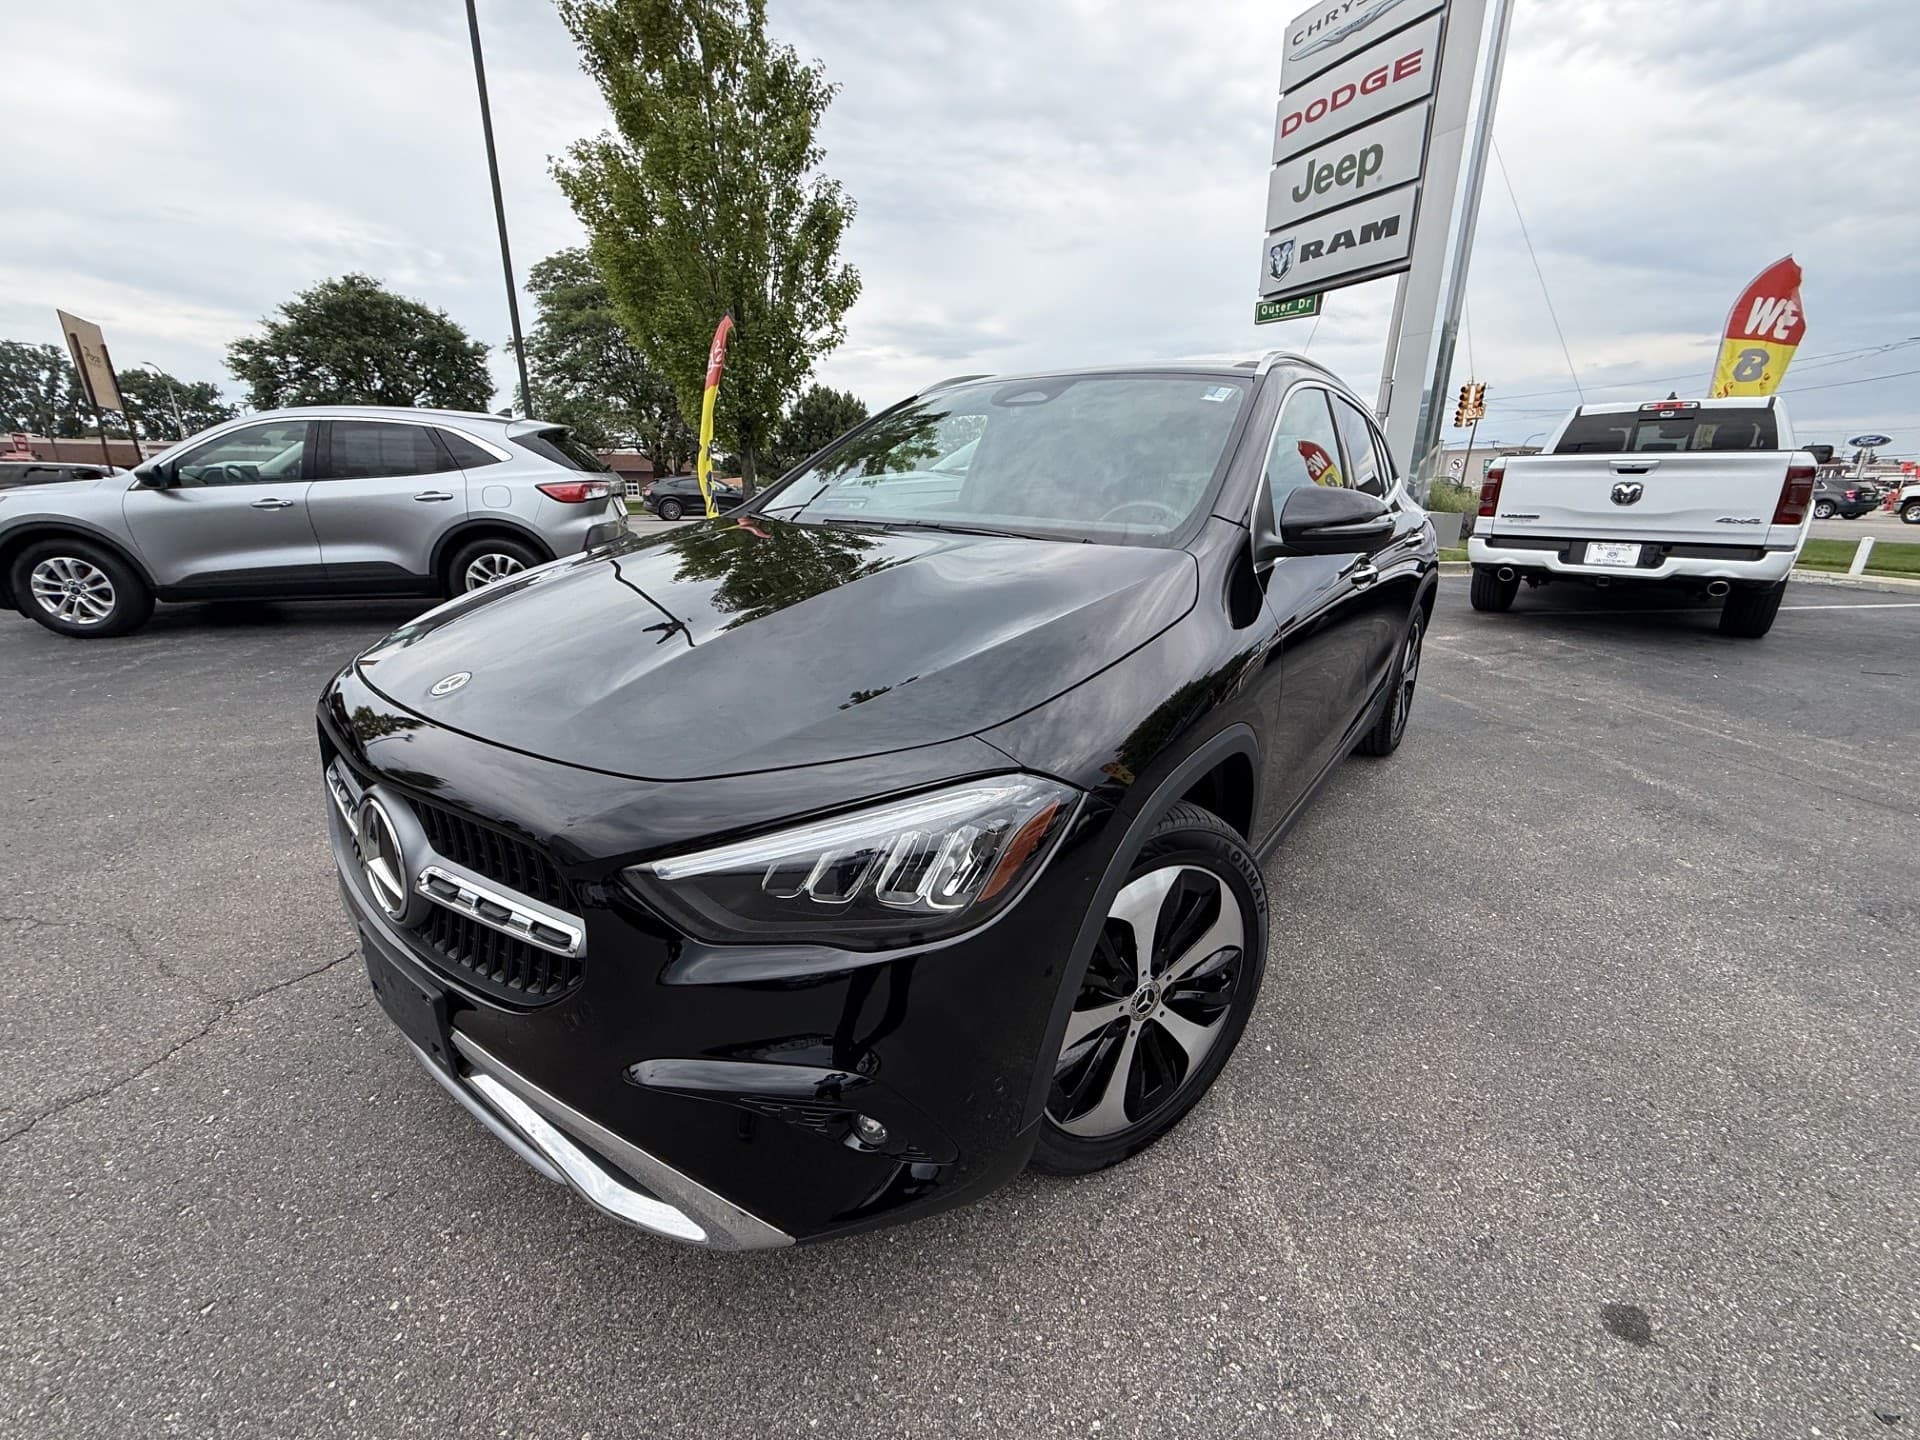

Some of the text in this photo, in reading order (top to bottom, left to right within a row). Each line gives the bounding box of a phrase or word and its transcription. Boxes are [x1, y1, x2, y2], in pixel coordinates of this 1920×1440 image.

[1281, 48, 1424, 138] DODGE
[1292, 143, 1384, 204] Jeep
[1299, 214, 1401, 264] RAM
[1261, 303, 1292, 315] Outer
[1298, 298, 1312, 309] Dr
[1744, 296, 1800, 340] WE
[1217, 840, 1266, 914] IRONMAN
